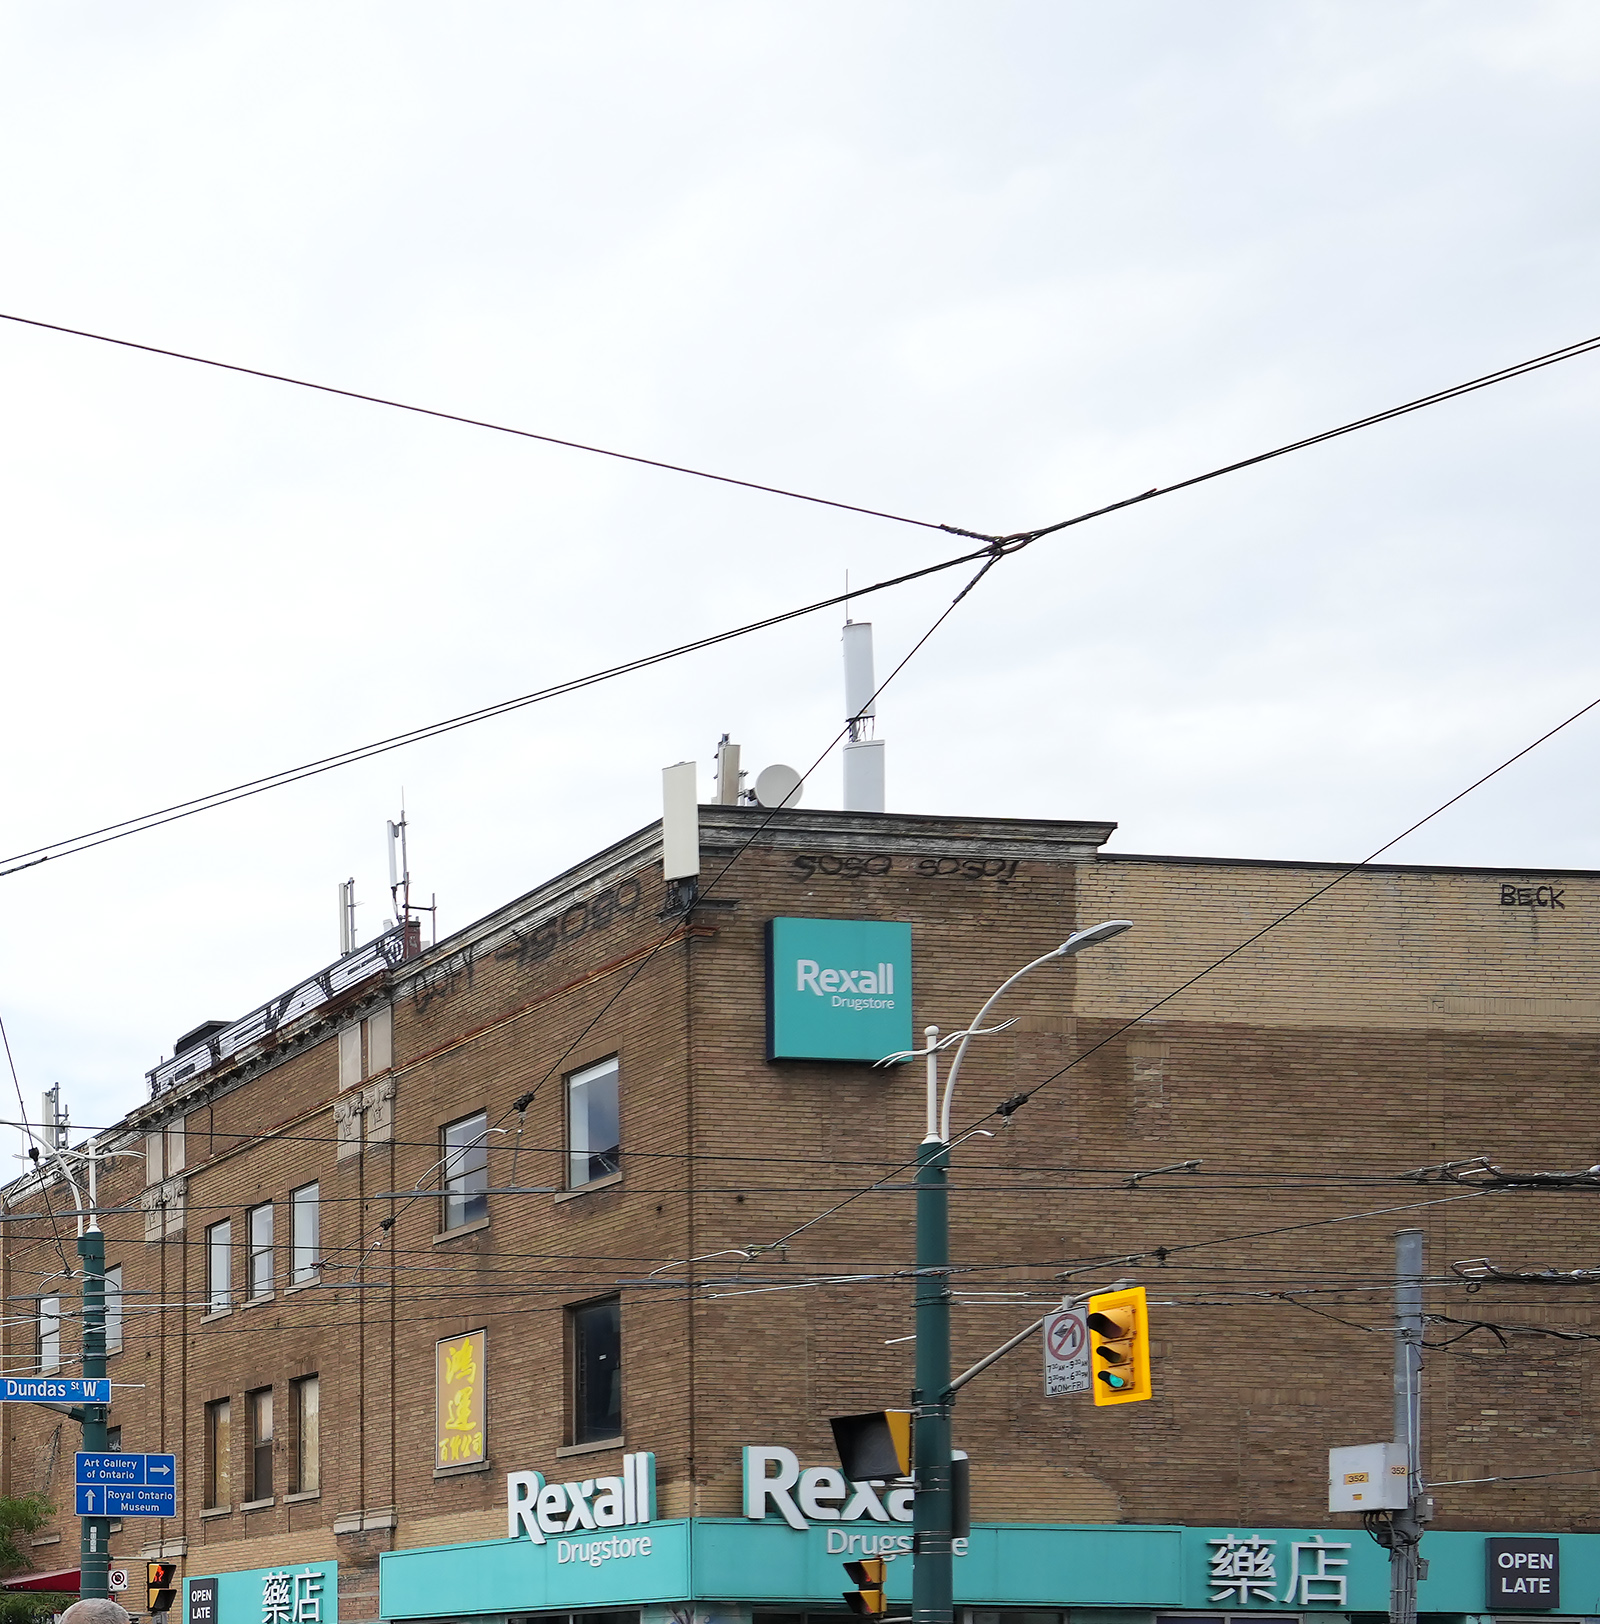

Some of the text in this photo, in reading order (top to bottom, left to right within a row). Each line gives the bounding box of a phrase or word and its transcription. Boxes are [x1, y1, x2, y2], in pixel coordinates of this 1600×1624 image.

[1501, 884, 1565, 909] BECK
[797, 959, 893, 996] Rexall
[832, 996, 894, 1011] Drugstore
[7, 1380, 97, 1397] Dundas St W
[84, 1459, 138, 1470] Art Gallery
[1391, 1466, 1406, 1475] 352
[86, 1470, 135, 1479] of Ontario
[1348, 1474, 1365, 1483] 352
[107, 1491, 173, 1501] Royal Ontario
[507, 1452, 653, 1544] Rexall
[120, 1502, 160, 1512] Museum
[557, 1535, 652, 1567] Drugstore
[1497, 1552, 1554, 1570] OPEN
[1205, 1534, 1352, 1605] 藥店
[1501, 1578, 1551, 1594] LATE
[191, 1589, 212, 1602] OPEN
[261, 1567, 325, 1624] 藥店
[192, 1607, 211, 1619] LATE
